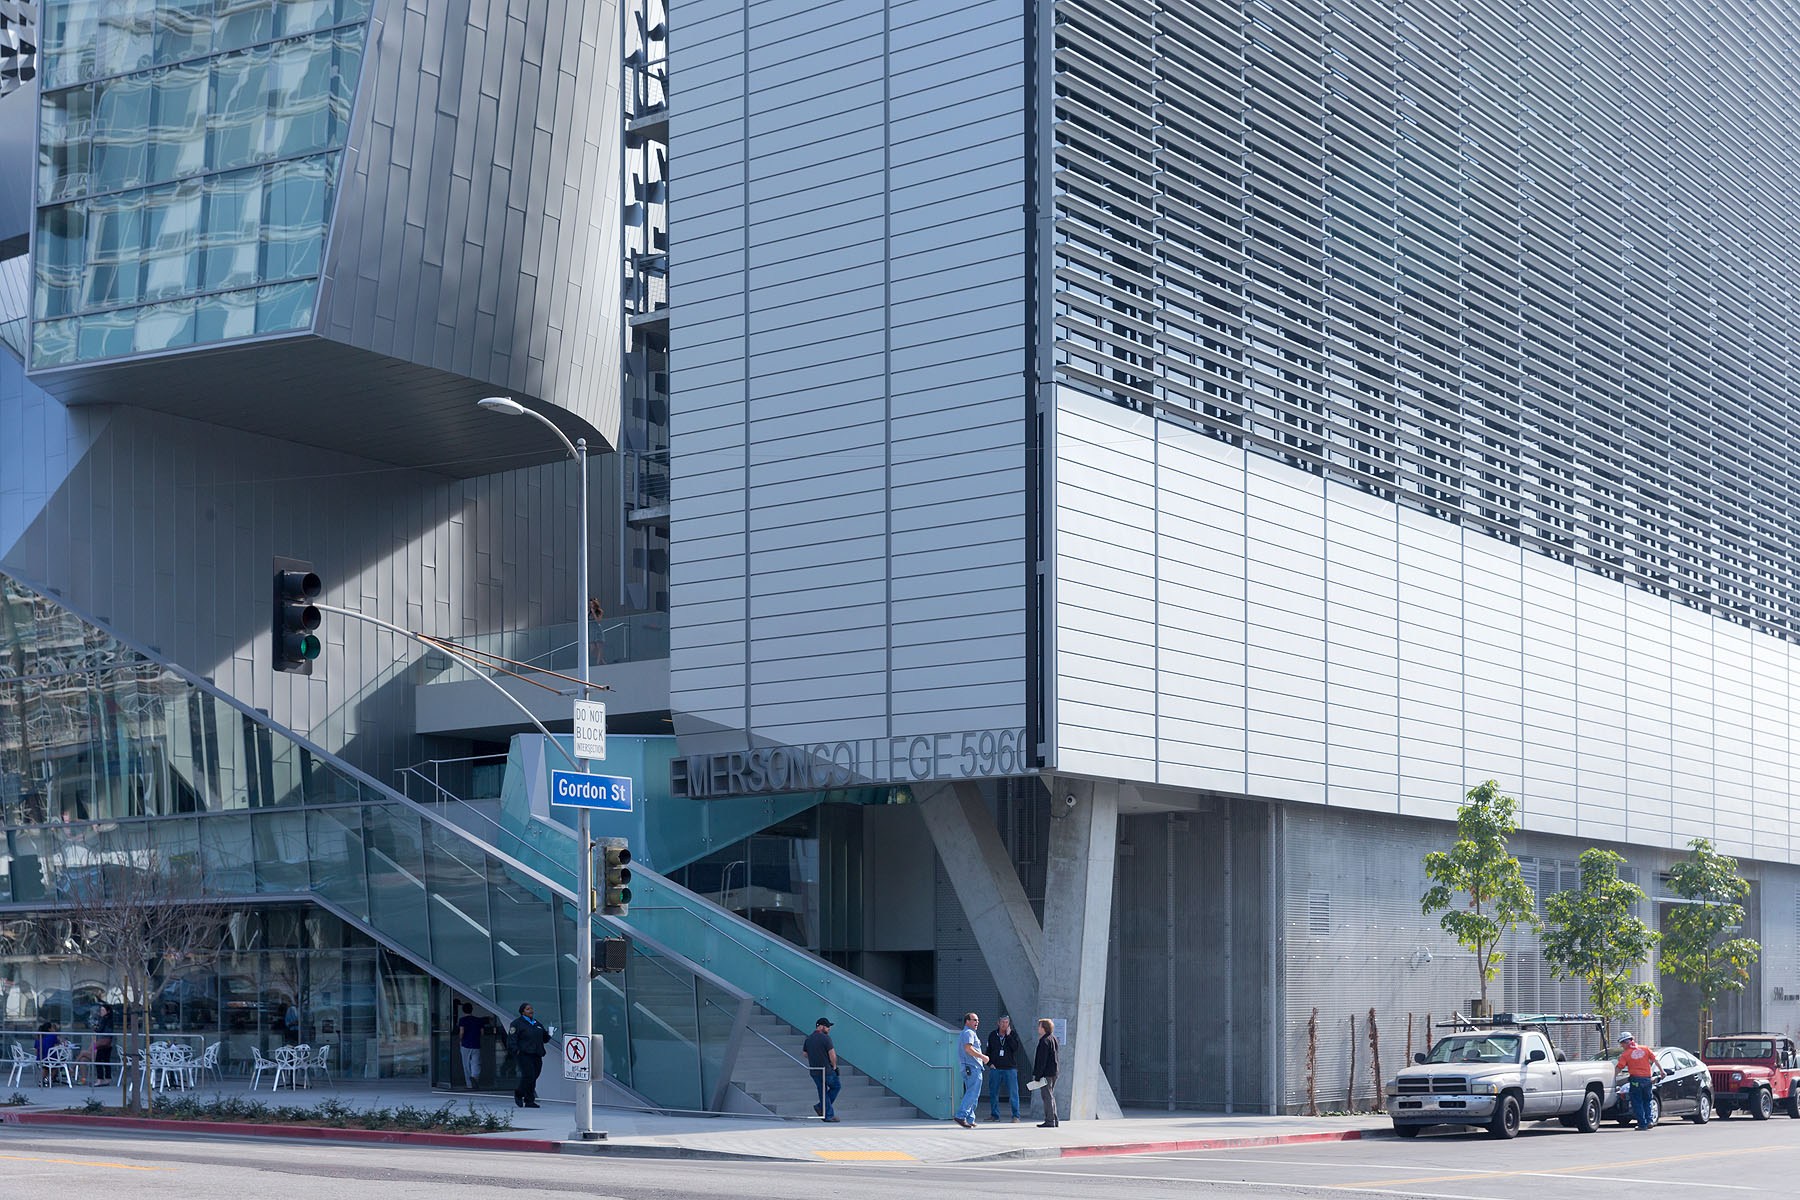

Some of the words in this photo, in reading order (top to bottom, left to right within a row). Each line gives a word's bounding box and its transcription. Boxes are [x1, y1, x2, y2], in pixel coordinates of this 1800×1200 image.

[576, 708, 586, 721] DO
[590, 710, 604, 723] NOT
[576, 727, 604, 742] BLOCK
[559, 778, 607, 800] Gordon
[611, 783, 626, 802] St
